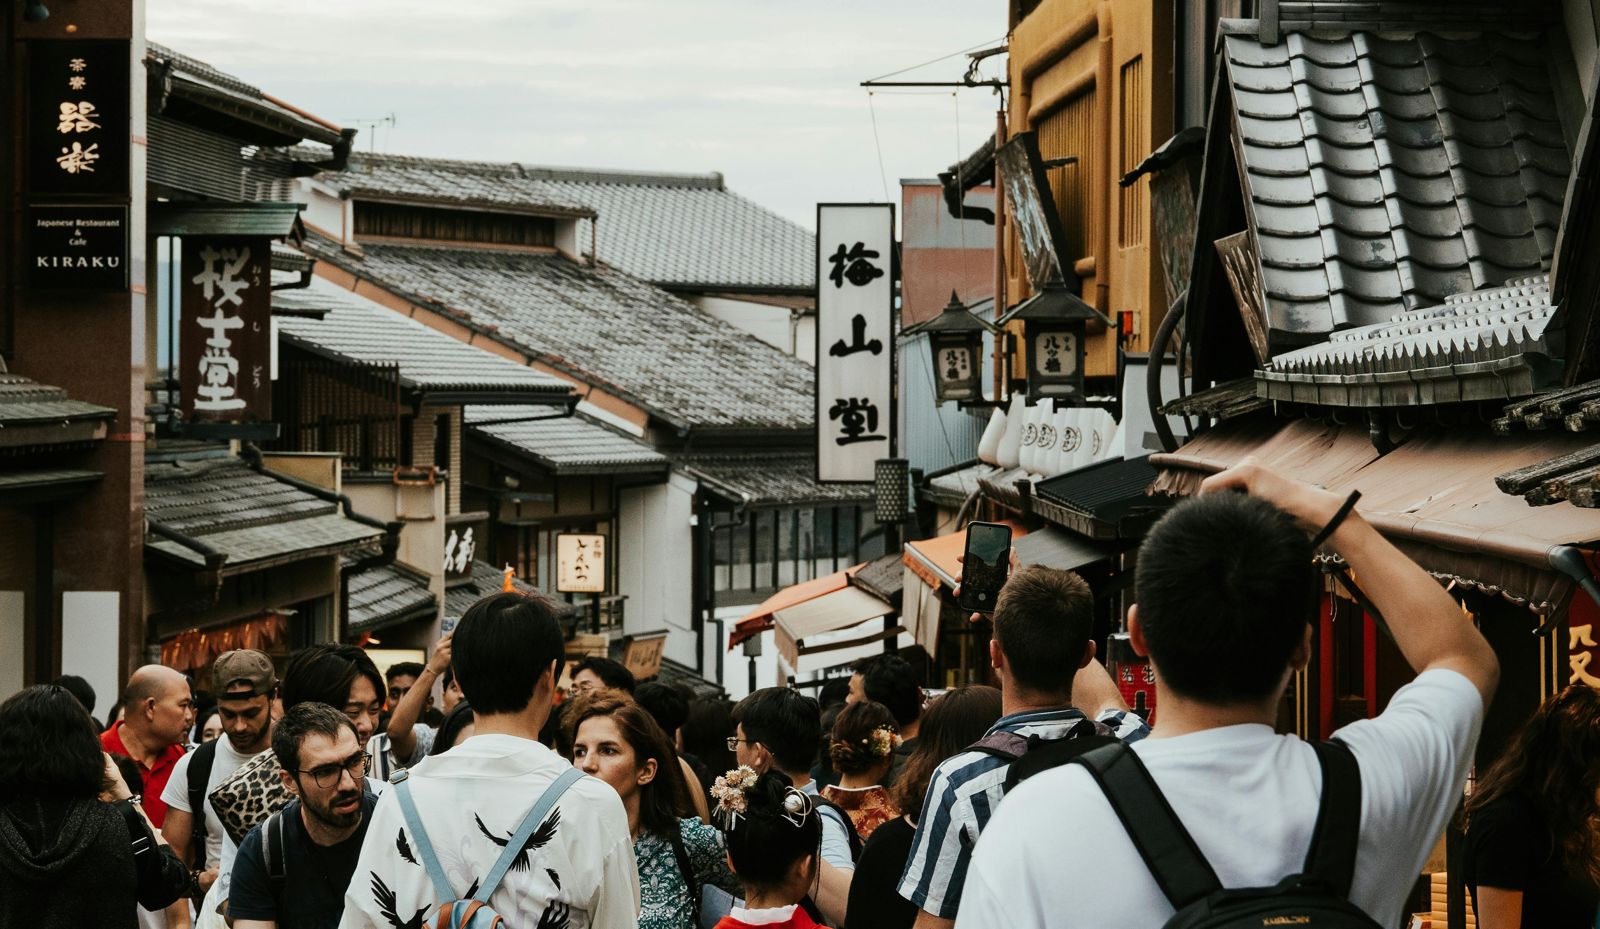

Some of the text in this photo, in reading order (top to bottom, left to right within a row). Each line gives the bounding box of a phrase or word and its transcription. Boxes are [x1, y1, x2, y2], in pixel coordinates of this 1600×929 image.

[37, 219, 120, 228] Japanese Restaurant
[74, 228, 82, 236] &
[68, 238, 87, 246] Cafe
[37, 256, 119, 268] KIRAKU
[828, 241, 887, 446] 梅山堂
